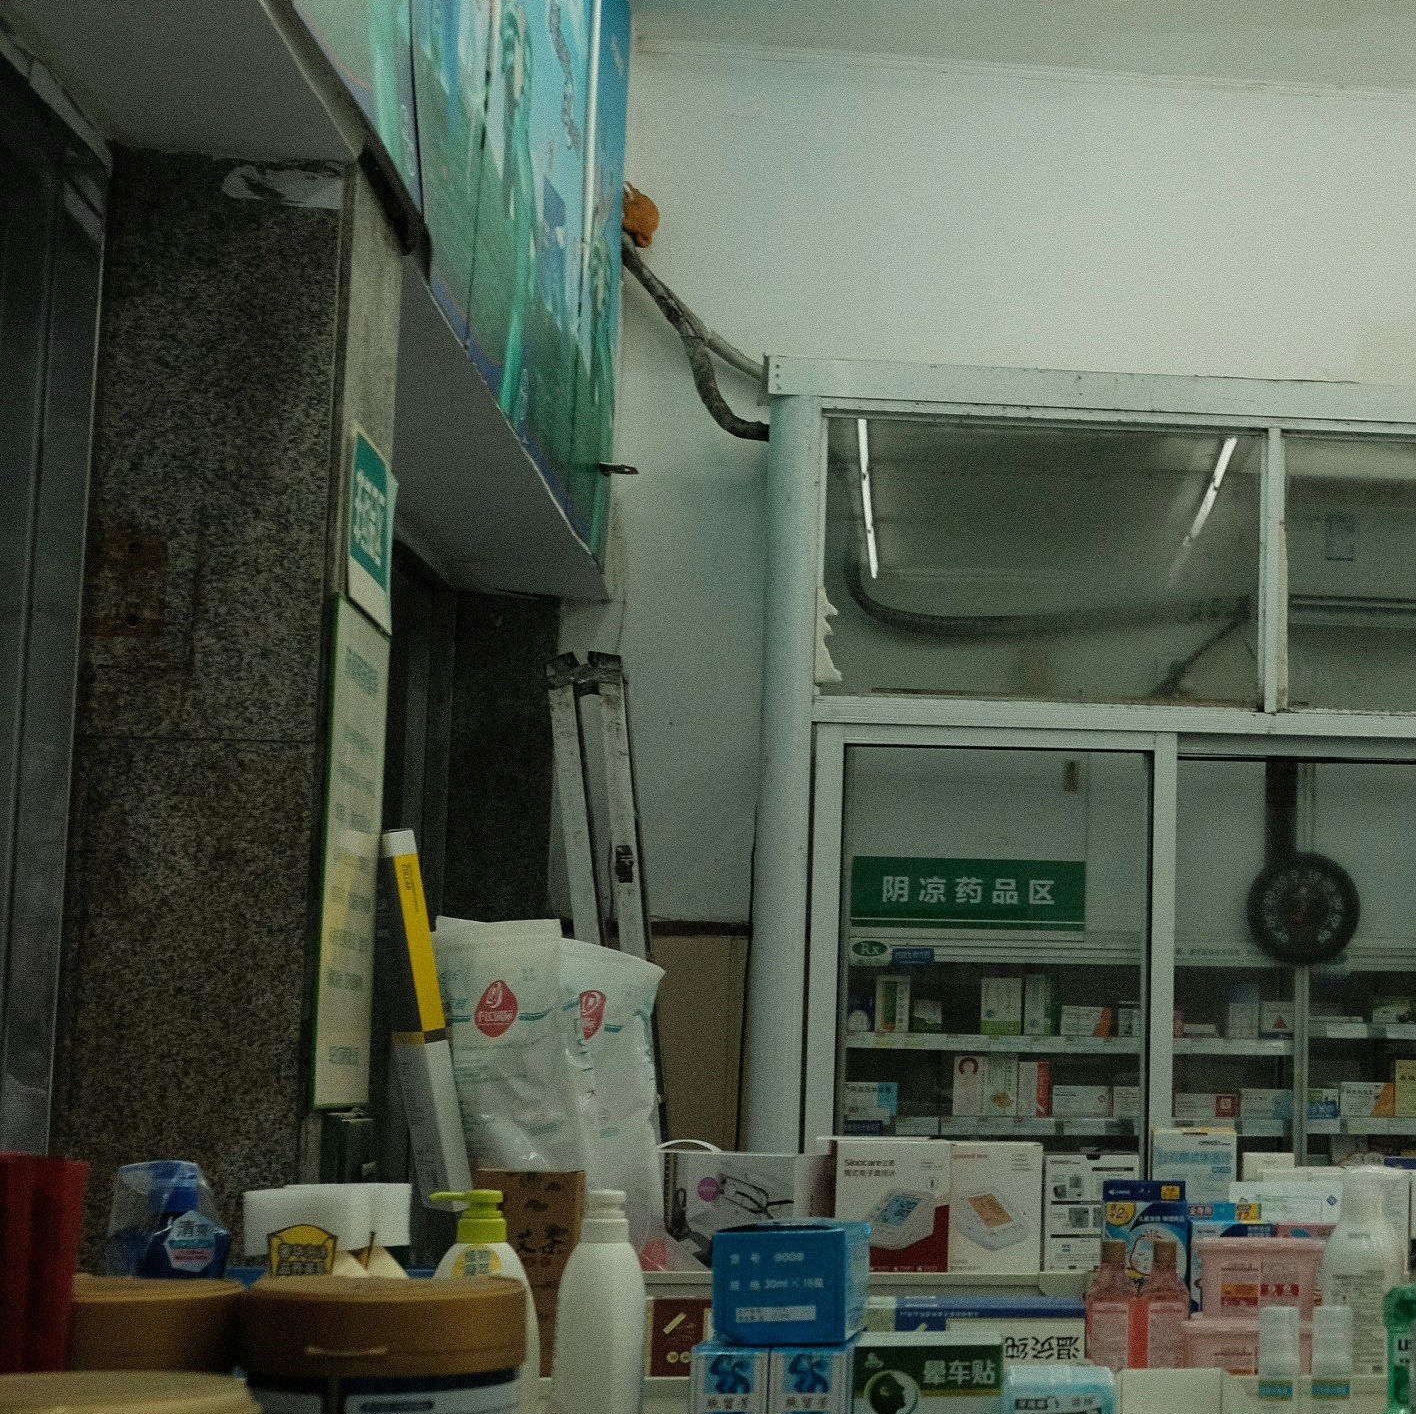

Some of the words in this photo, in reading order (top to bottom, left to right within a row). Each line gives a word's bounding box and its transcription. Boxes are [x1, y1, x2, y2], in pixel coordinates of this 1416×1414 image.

[881, 875, 1056, 906] 阴凉药品区
[922, 1359, 997, 1385] 晕车贴
